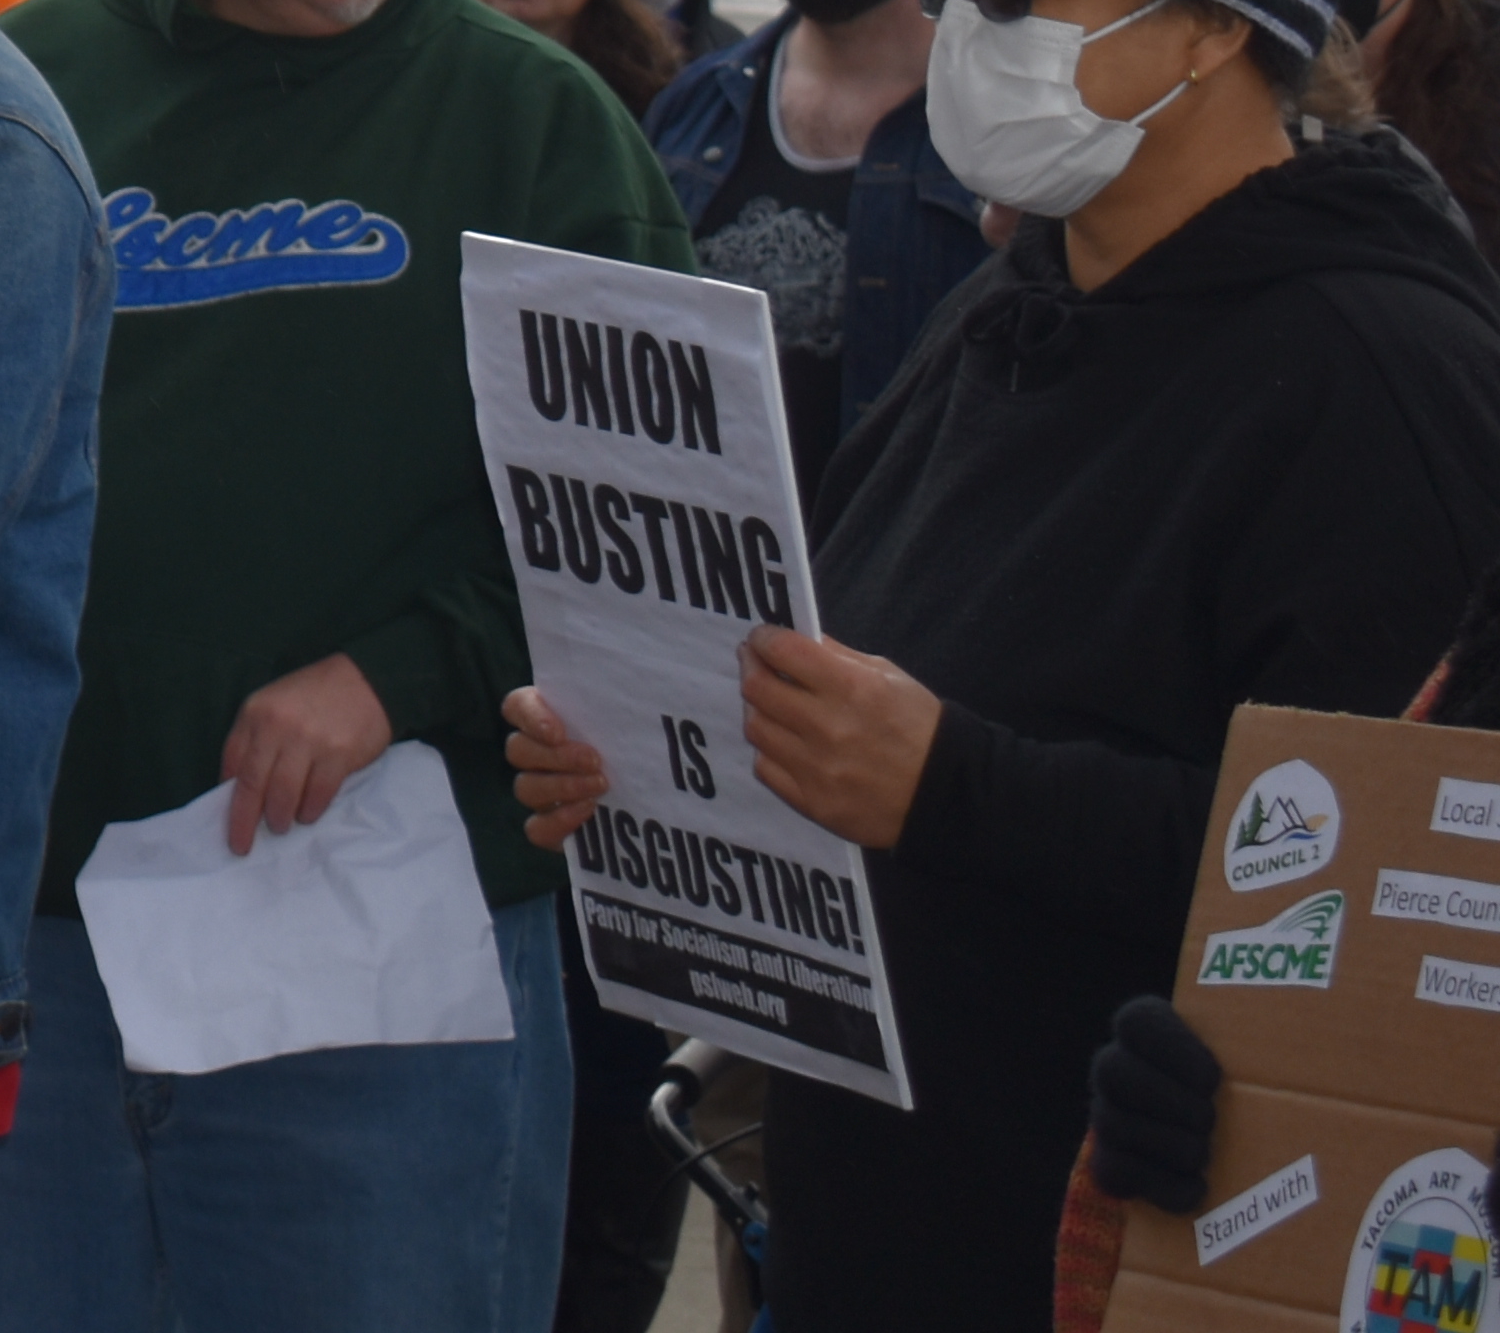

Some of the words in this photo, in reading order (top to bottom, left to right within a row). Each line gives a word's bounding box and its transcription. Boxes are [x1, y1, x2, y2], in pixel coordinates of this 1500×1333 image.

[519, 308, 722, 457] UNION
[506, 463, 796, 631] BUSTING
[660, 713, 717, 801] IS
[1440, 793, 1493, 827] Local
[575, 803, 866, 956] DISGUSTING!
[1231, 847, 1307, 882] COUNCIL
[1310, 843, 1321, 861] 2
[1378, 882, 1441, 915] Pierce
[583, 893, 632, 941] Party
[633, 911, 659, 944] for
[661, 918, 751, 972] Socialism
[751, 950, 786, 982] and
[786, 955, 876, 1014] Liberation
[1200, 943, 1331, 980] AFSCME
[689, 970, 789, 1026] pslweb.org
[1201, 1200, 1261, 1251] Stand
[1262, 1169, 1310, 1219] with
[1361, 1179, 1419, 1251] TACOMA
[1428, 1171, 1462, 1192] ART
[1381, 1249, 1482, 1326] TAM
